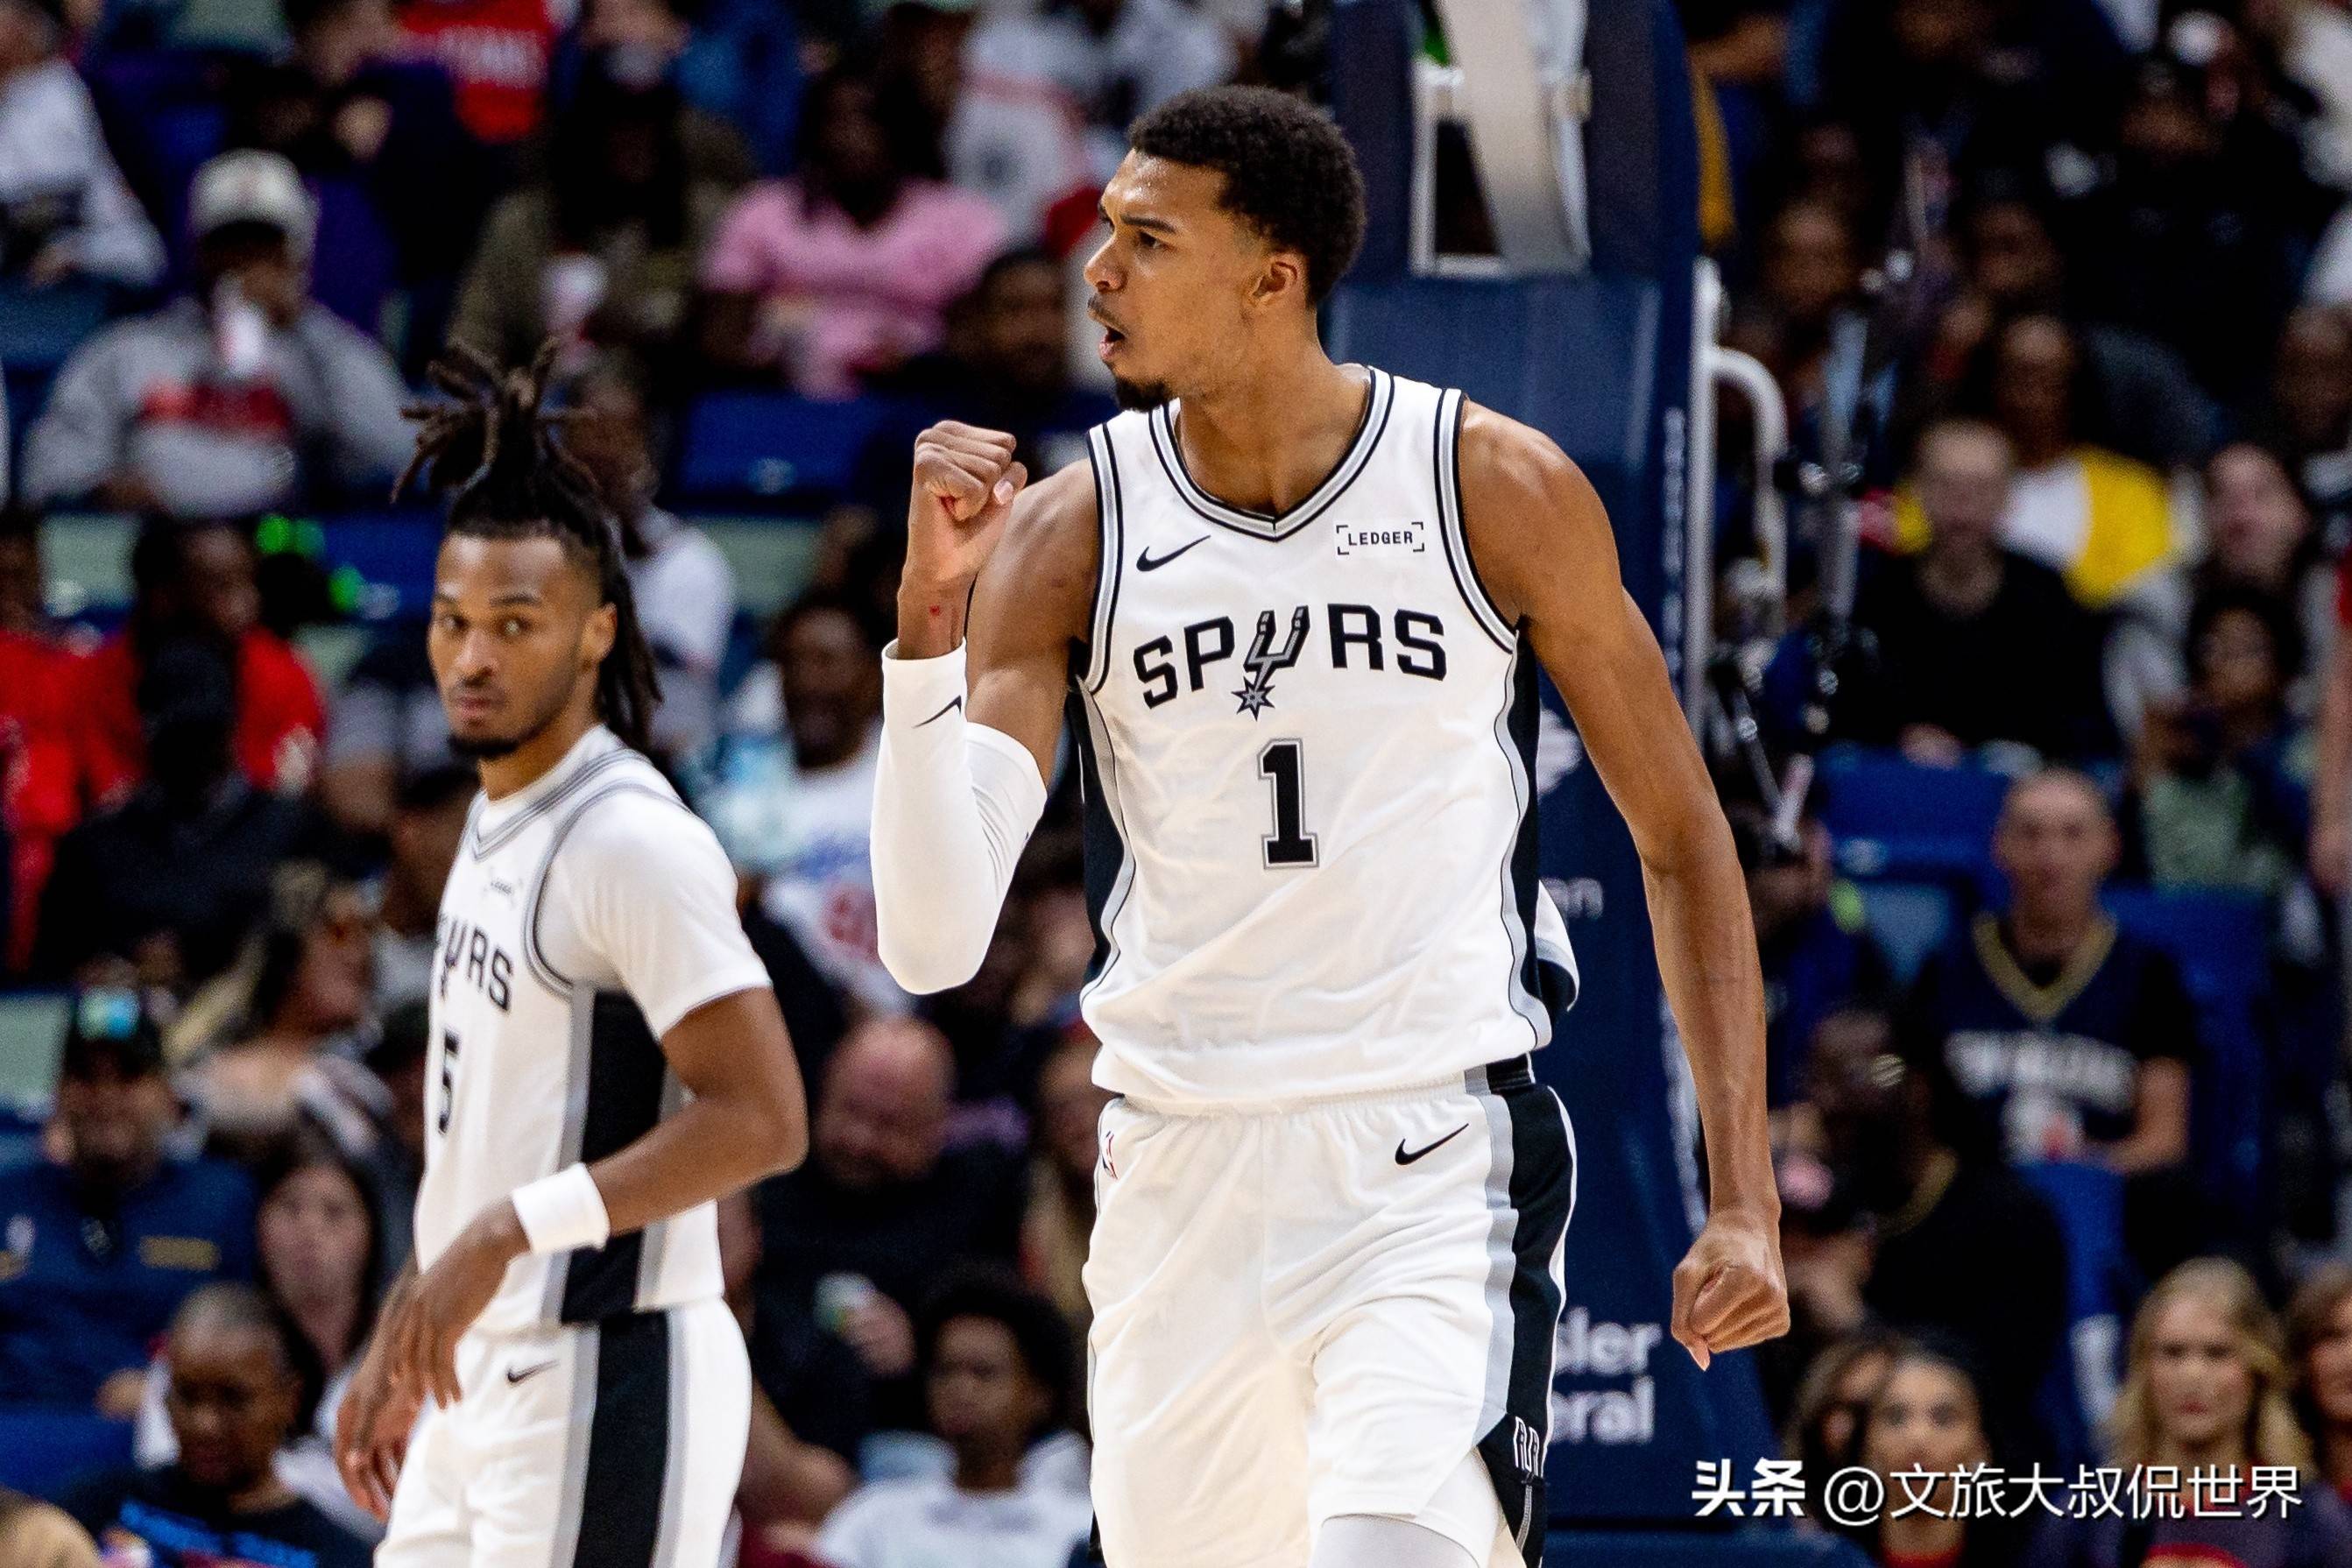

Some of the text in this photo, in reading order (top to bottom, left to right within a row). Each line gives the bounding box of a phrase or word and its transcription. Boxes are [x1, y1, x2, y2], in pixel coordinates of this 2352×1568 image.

[1348, 531, 1413, 546] LEDGER
[1134, 604, 1447, 720] SPURS
[1257, 737, 1319, 870] 1
